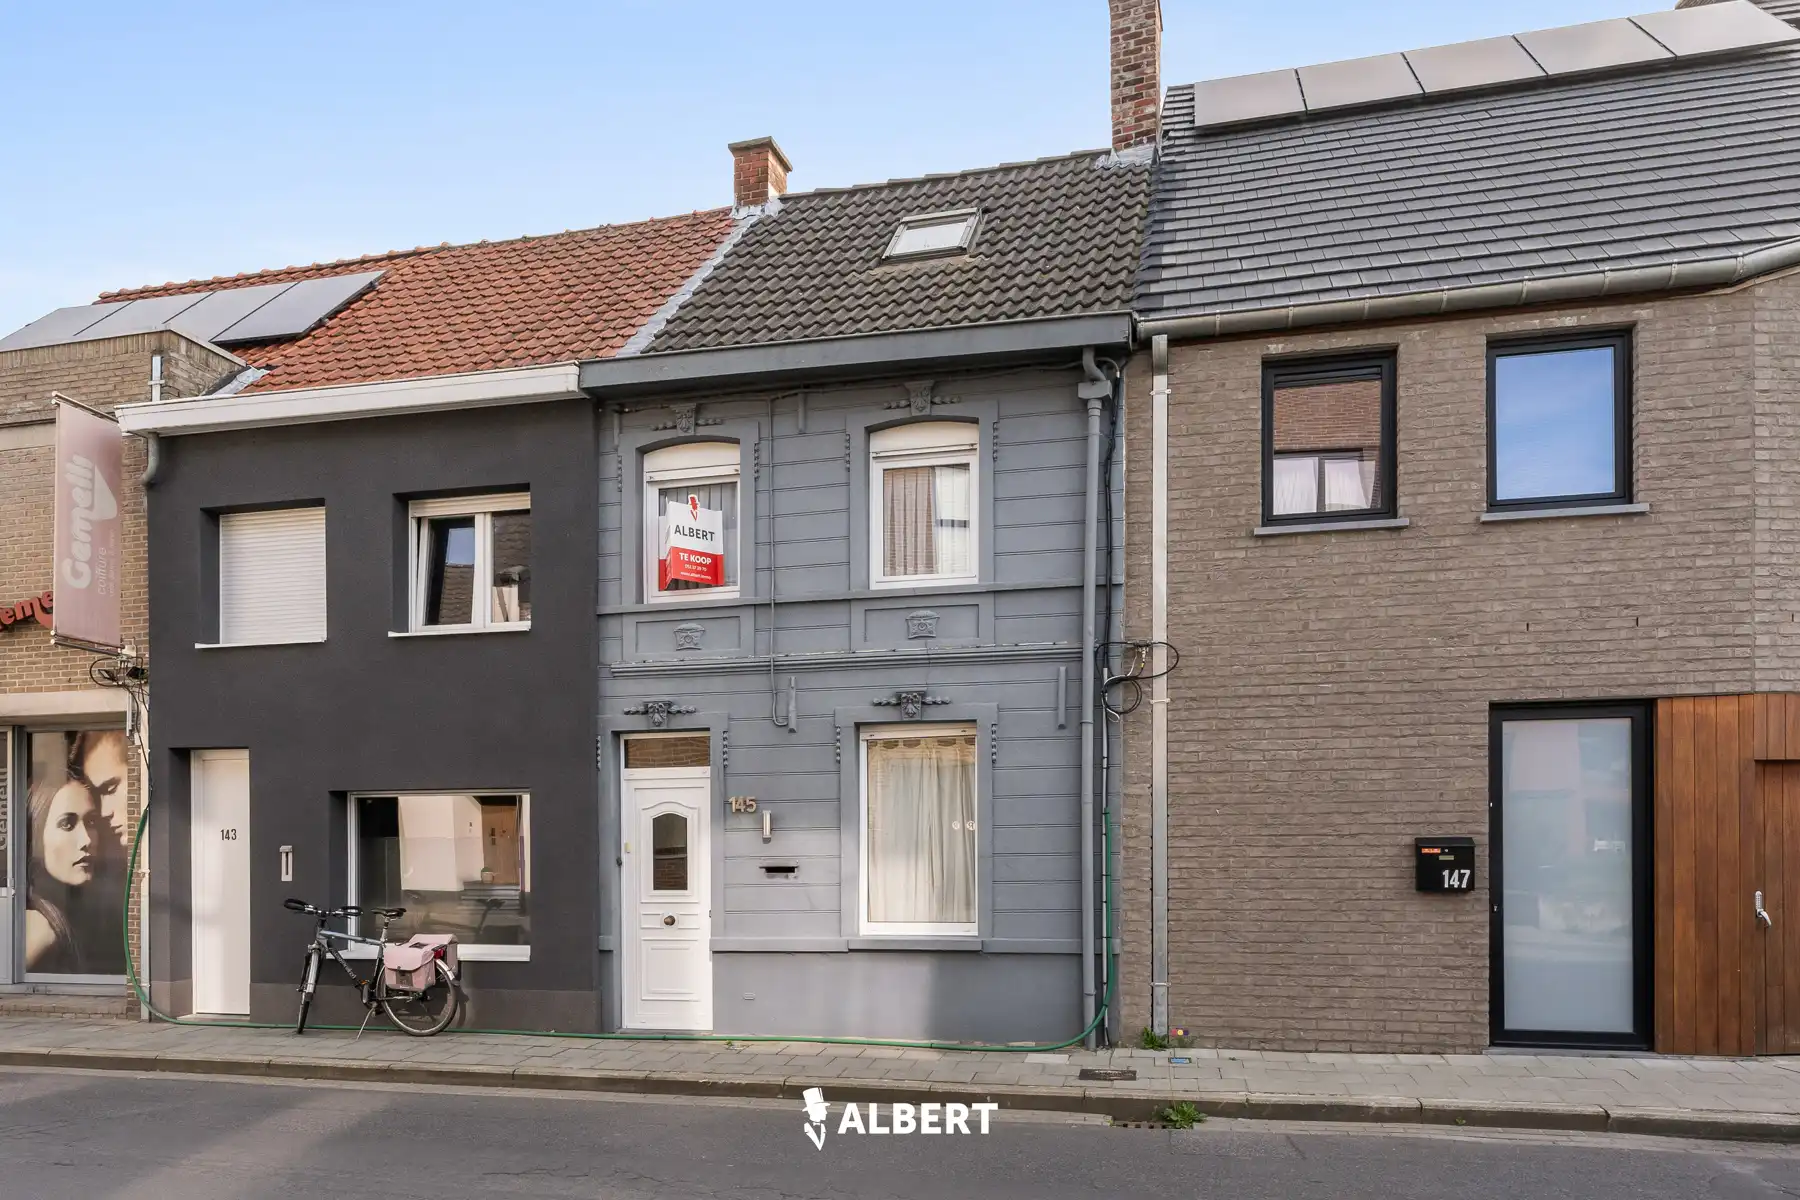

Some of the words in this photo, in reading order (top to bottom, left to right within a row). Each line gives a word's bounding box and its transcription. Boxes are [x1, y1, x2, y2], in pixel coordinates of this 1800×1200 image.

[61, 454, 118, 589] Gemelli
[674, 524, 715, 541] ALBERT
[679, 552, 688, 561] TE
[690, 554, 712, 565] KOOP
[728, 796, 757, 813] 145
[220, 828, 237, 841] 143
[1442, 869, 1471, 888] 147
